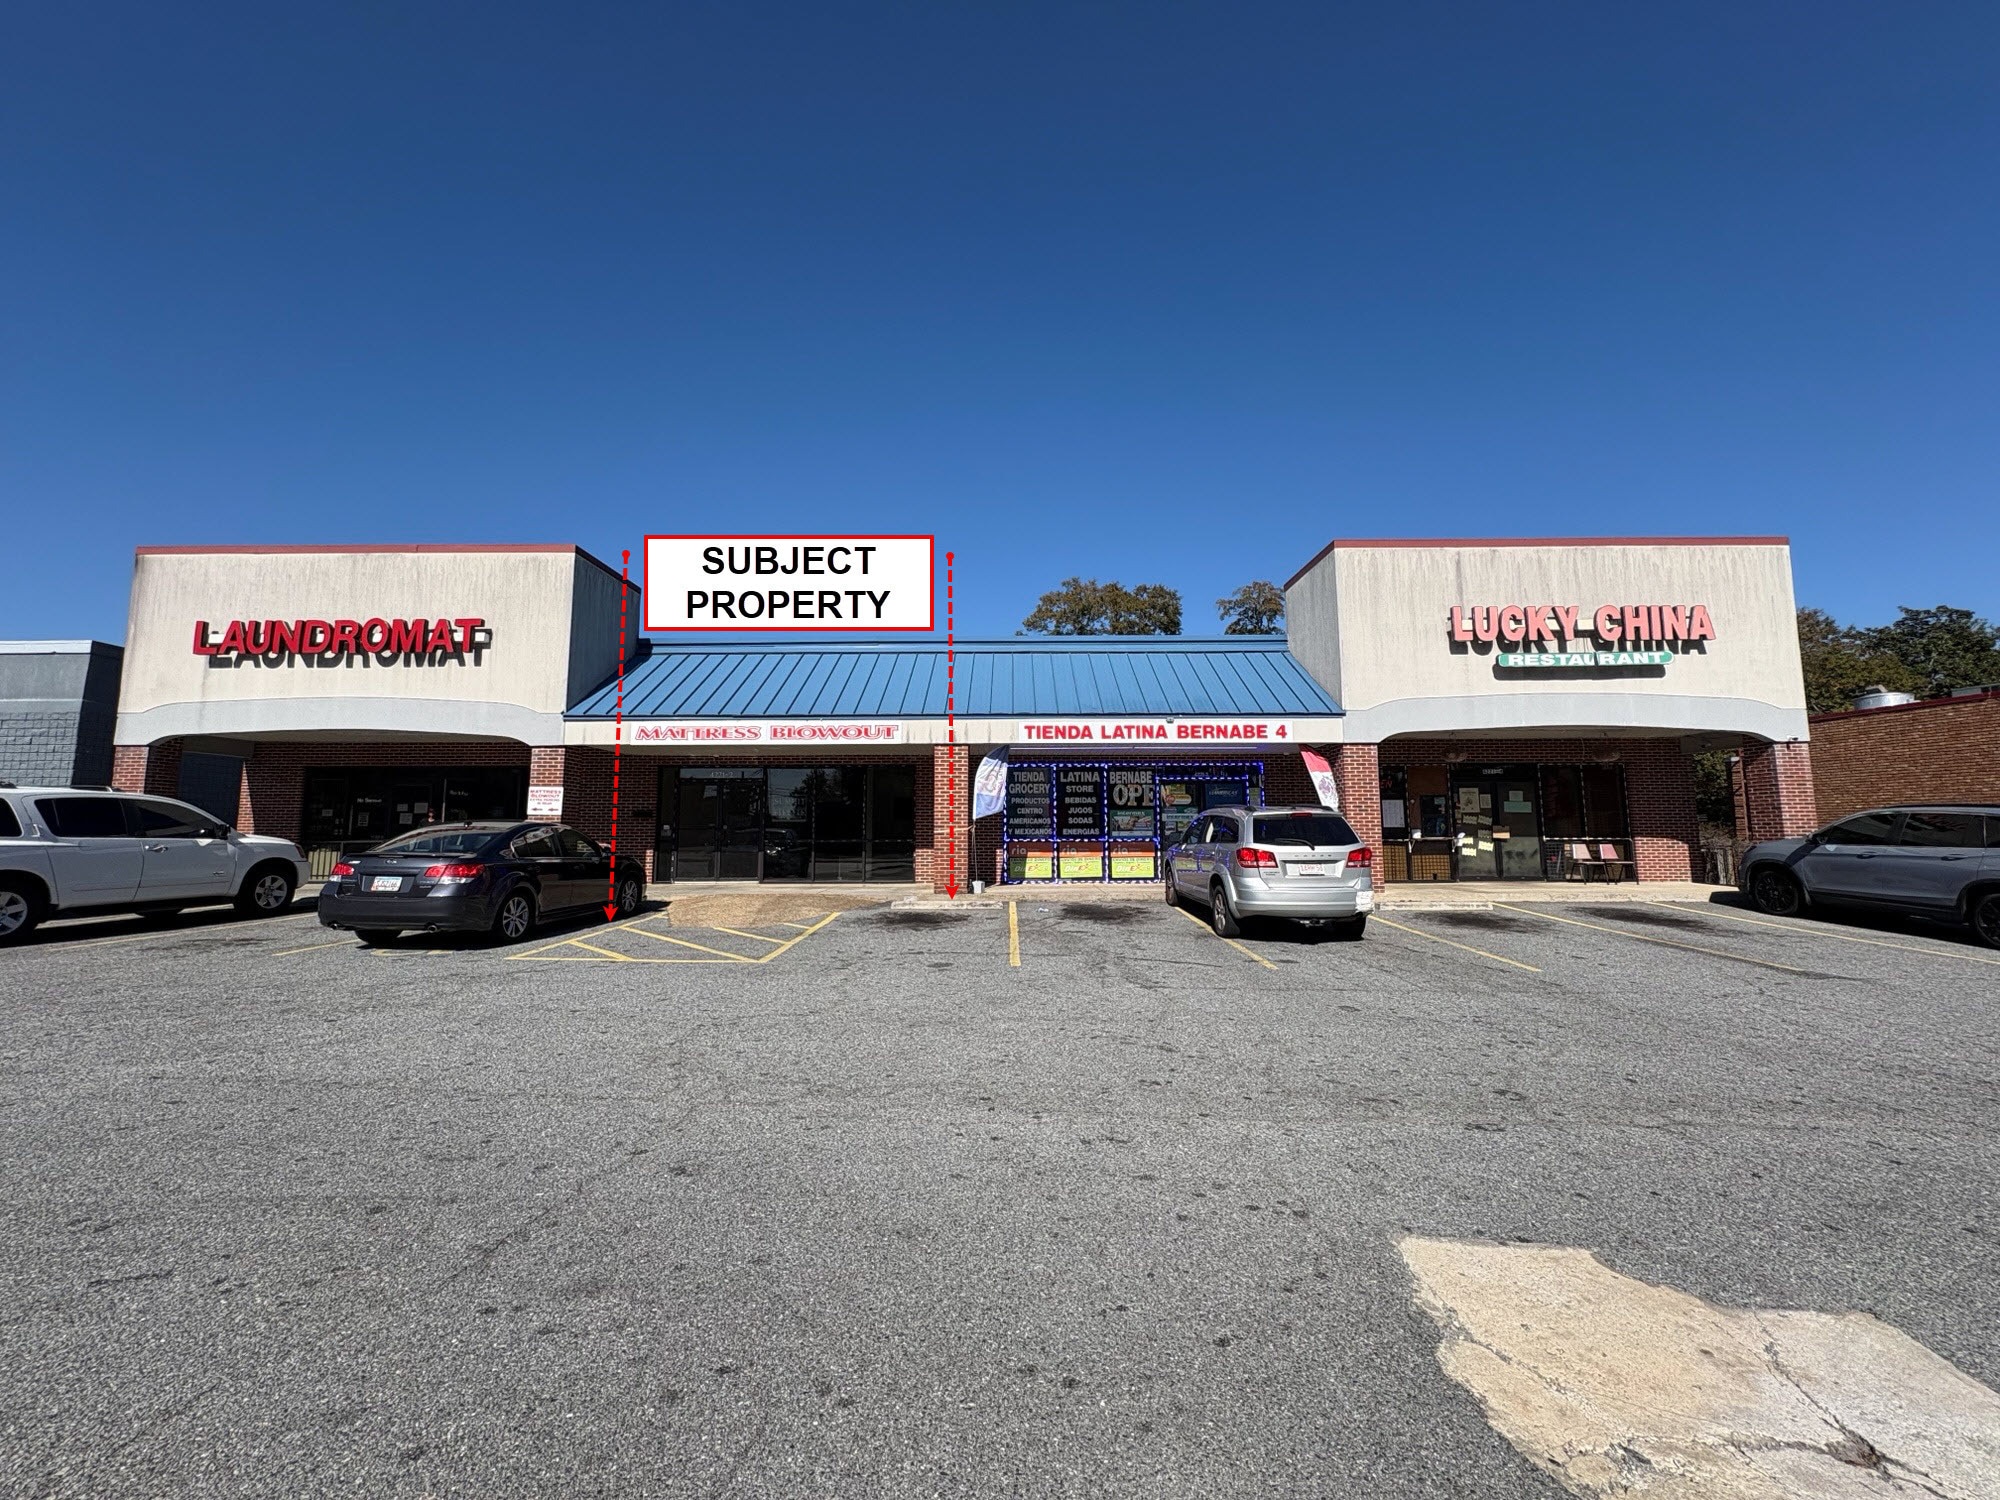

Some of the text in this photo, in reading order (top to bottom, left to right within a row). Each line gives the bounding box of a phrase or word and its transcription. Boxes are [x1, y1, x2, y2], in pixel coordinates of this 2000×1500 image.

[1450, 605, 1716, 641] LUCKY CHINA
[193, 618, 485, 655] LAUNDROMAT
[1508, 652, 1666, 666] RESTAURANT
[635, 725, 898, 740] MATTRESS BLOWOUT
[1024, 725, 1288, 740] TIENDA LATINA BERNABE 4
[1013, 771, 1045, 782] TIENDA
[1060, 771, 1101, 782] LATINA
[1109, 771, 1153, 784] BERNABE
[1009, 783, 1051, 794] GROCERY
[1066, 785, 1094, 793] STORE
